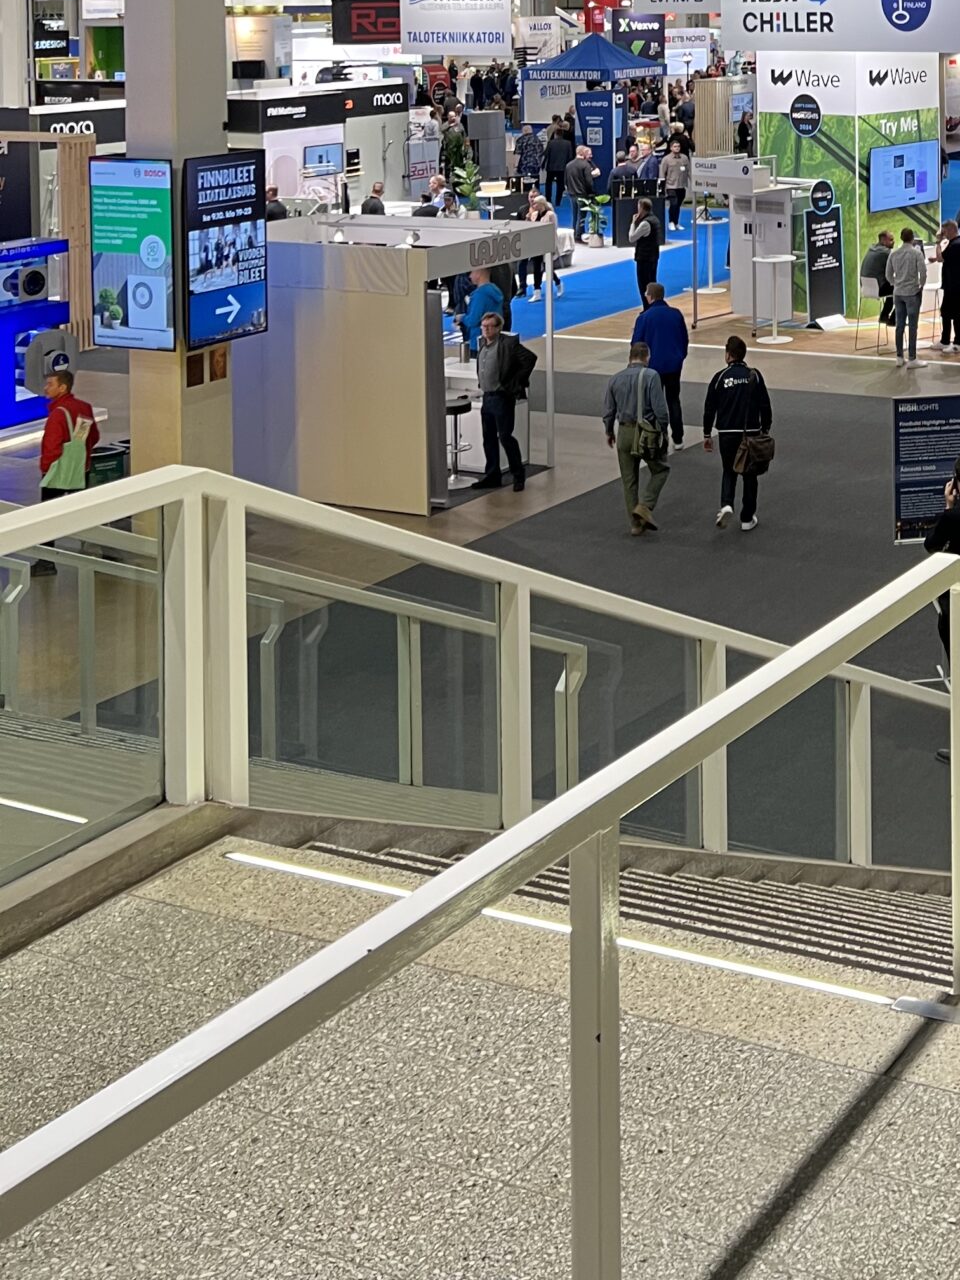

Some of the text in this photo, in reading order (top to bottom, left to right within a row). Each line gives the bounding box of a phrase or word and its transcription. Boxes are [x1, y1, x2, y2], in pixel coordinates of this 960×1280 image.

[351, 9, 400, 33] Ro
[630, 21, 660, 31] Vexve
[407, 31, 505, 44] TALOTEKNIIKKATORI
[529, 71, 601, 80] TALOTEKNIIKKATORI
[794, 69, 841, 88] Wave
[890, 67, 927, 85] Wave
[547, 84, 571, 97] TALTEKA
[373, 92, 403, 107] mora
[50, 120, 94, 134] mora
[880, 117, 918, 137] Try Me
[144, 169, 167, 177] BOSCH
[198, 165, 256, 189] FINNBILEET
[469, 233, 522, 267] LAJAC
[239, 266, 266, 285] BILEET
[899, 403, 940, 412] HIGHLIGHTS
